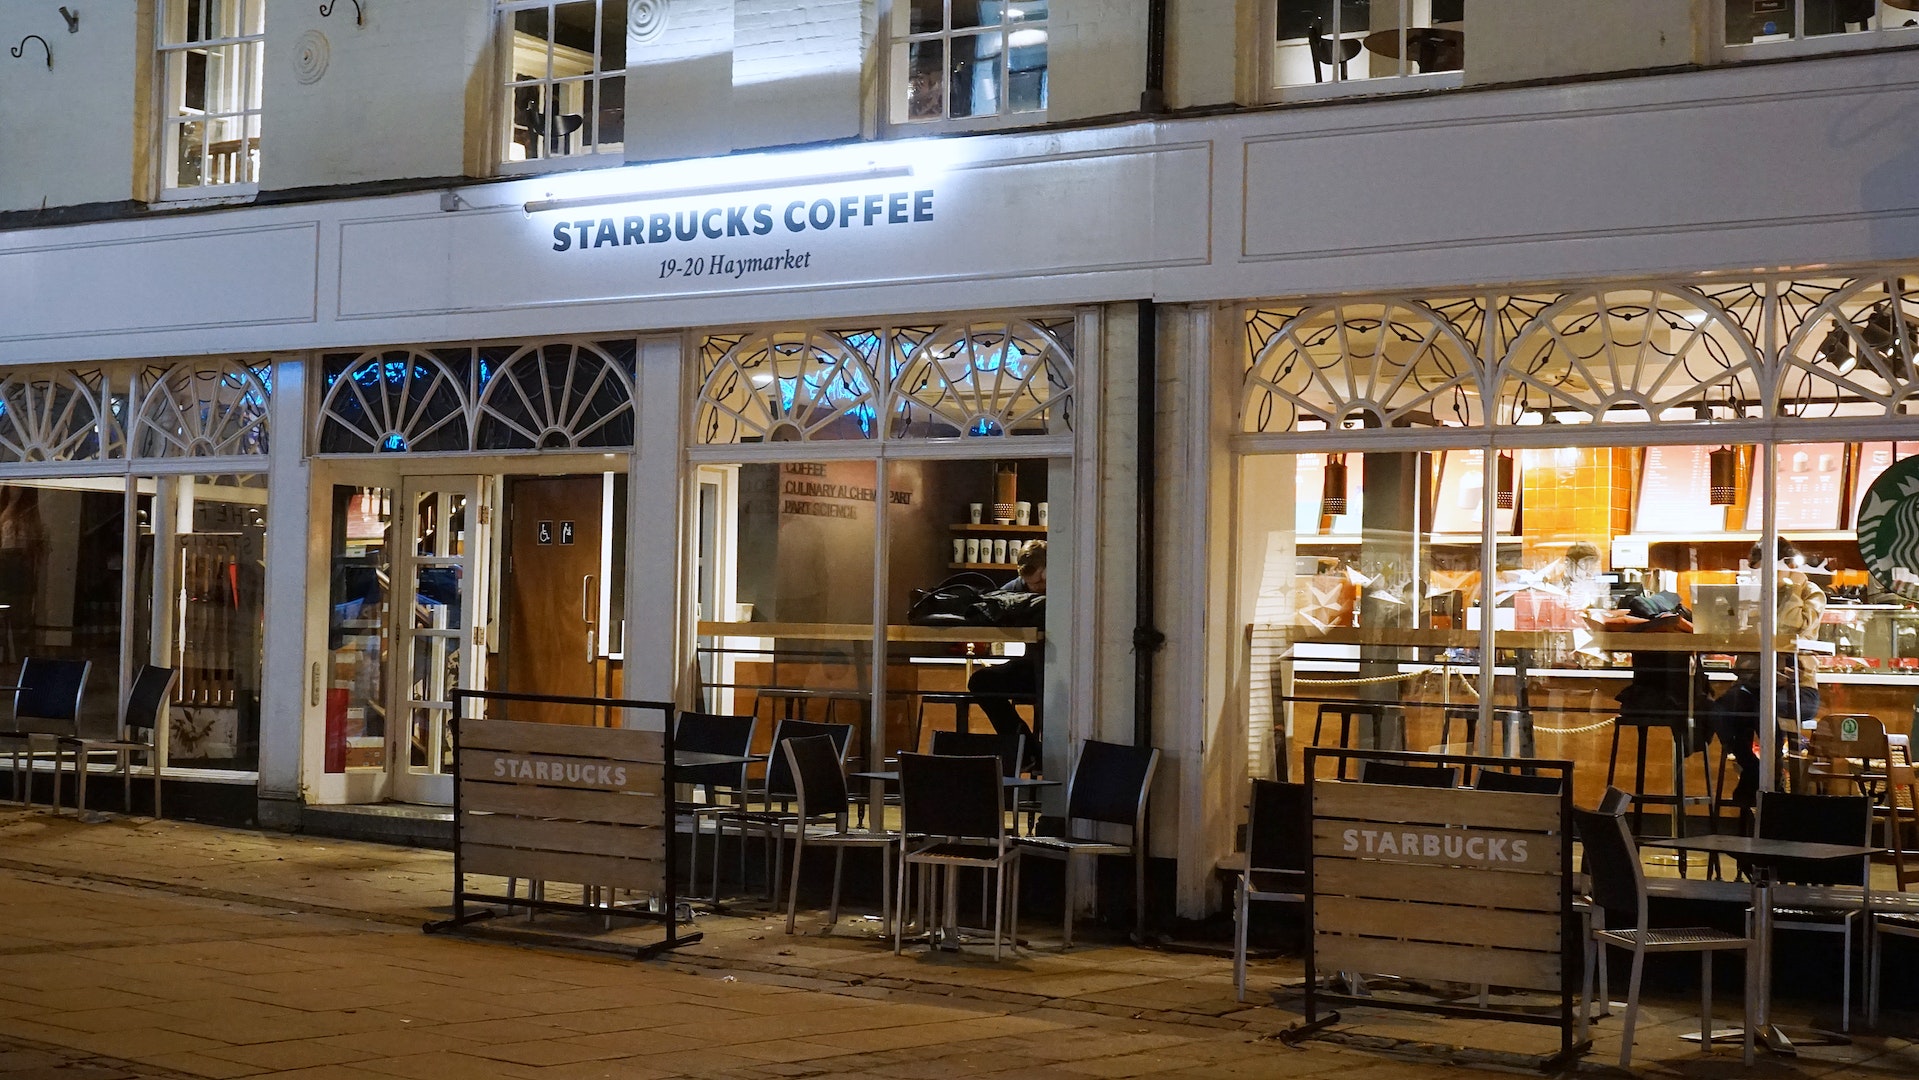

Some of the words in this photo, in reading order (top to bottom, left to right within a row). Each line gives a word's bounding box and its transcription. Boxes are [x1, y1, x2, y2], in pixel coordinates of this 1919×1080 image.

[552, 203, 774, 252] STARBUCKS
[784, 190, 934, 233] COFFEE
[659, 257, 704, 279] 19-20
[708, 250, 811, 279] Haymarket
[784, 480, 836, 497] CULINARY
[494, 758, 627, 786] STARBUCKS
[1343, 829, 1528, 863] STARBUCKS
